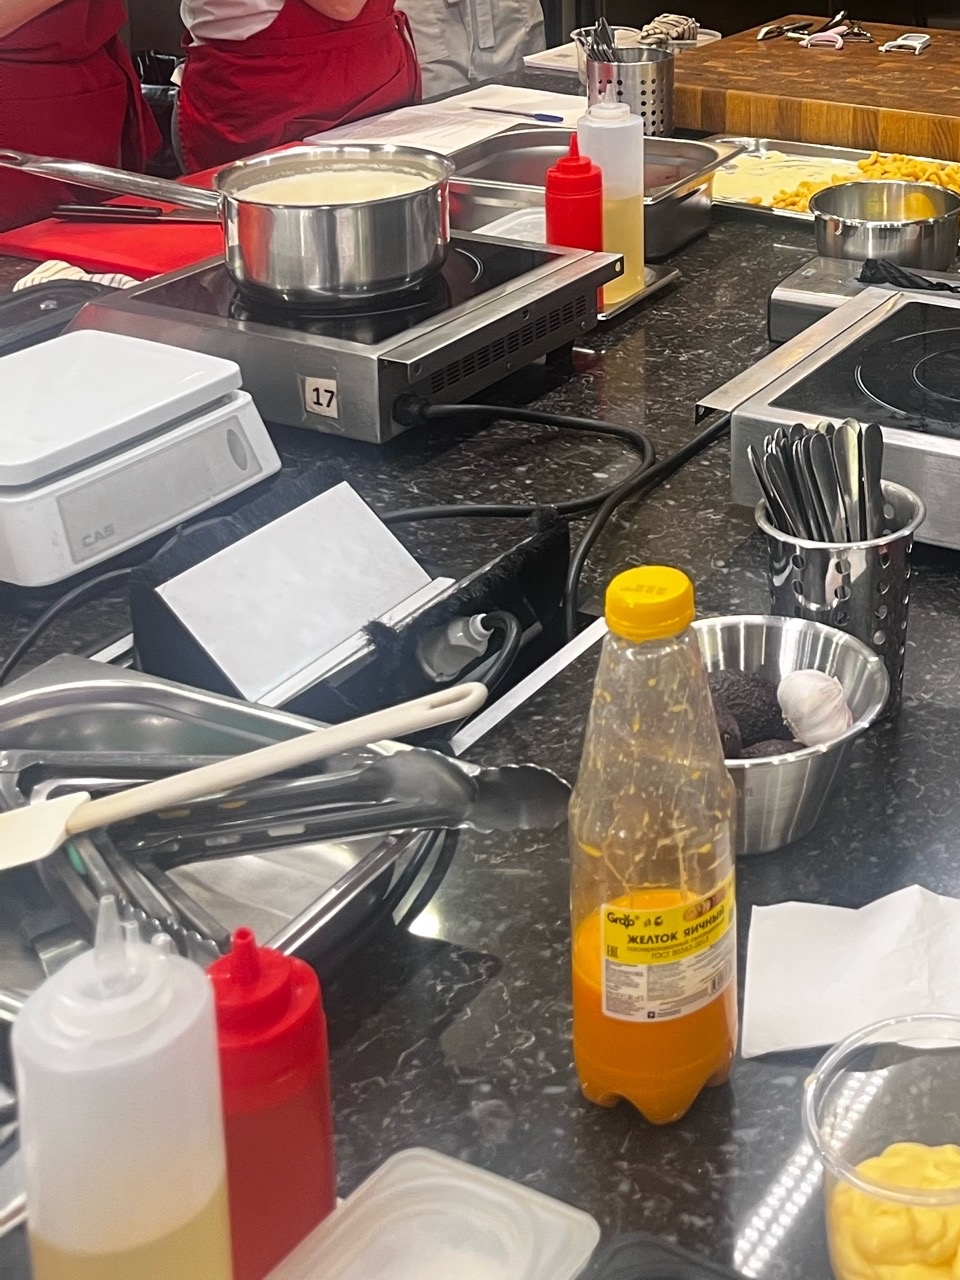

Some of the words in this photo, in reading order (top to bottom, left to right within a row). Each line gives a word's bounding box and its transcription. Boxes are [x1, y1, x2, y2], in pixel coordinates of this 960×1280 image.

[312, 387, 335, 408] 17
[627, 931, 678, 945] ЖЕЛТОК
[683, 904, 725, 937] ЯИЧНЫЙ
